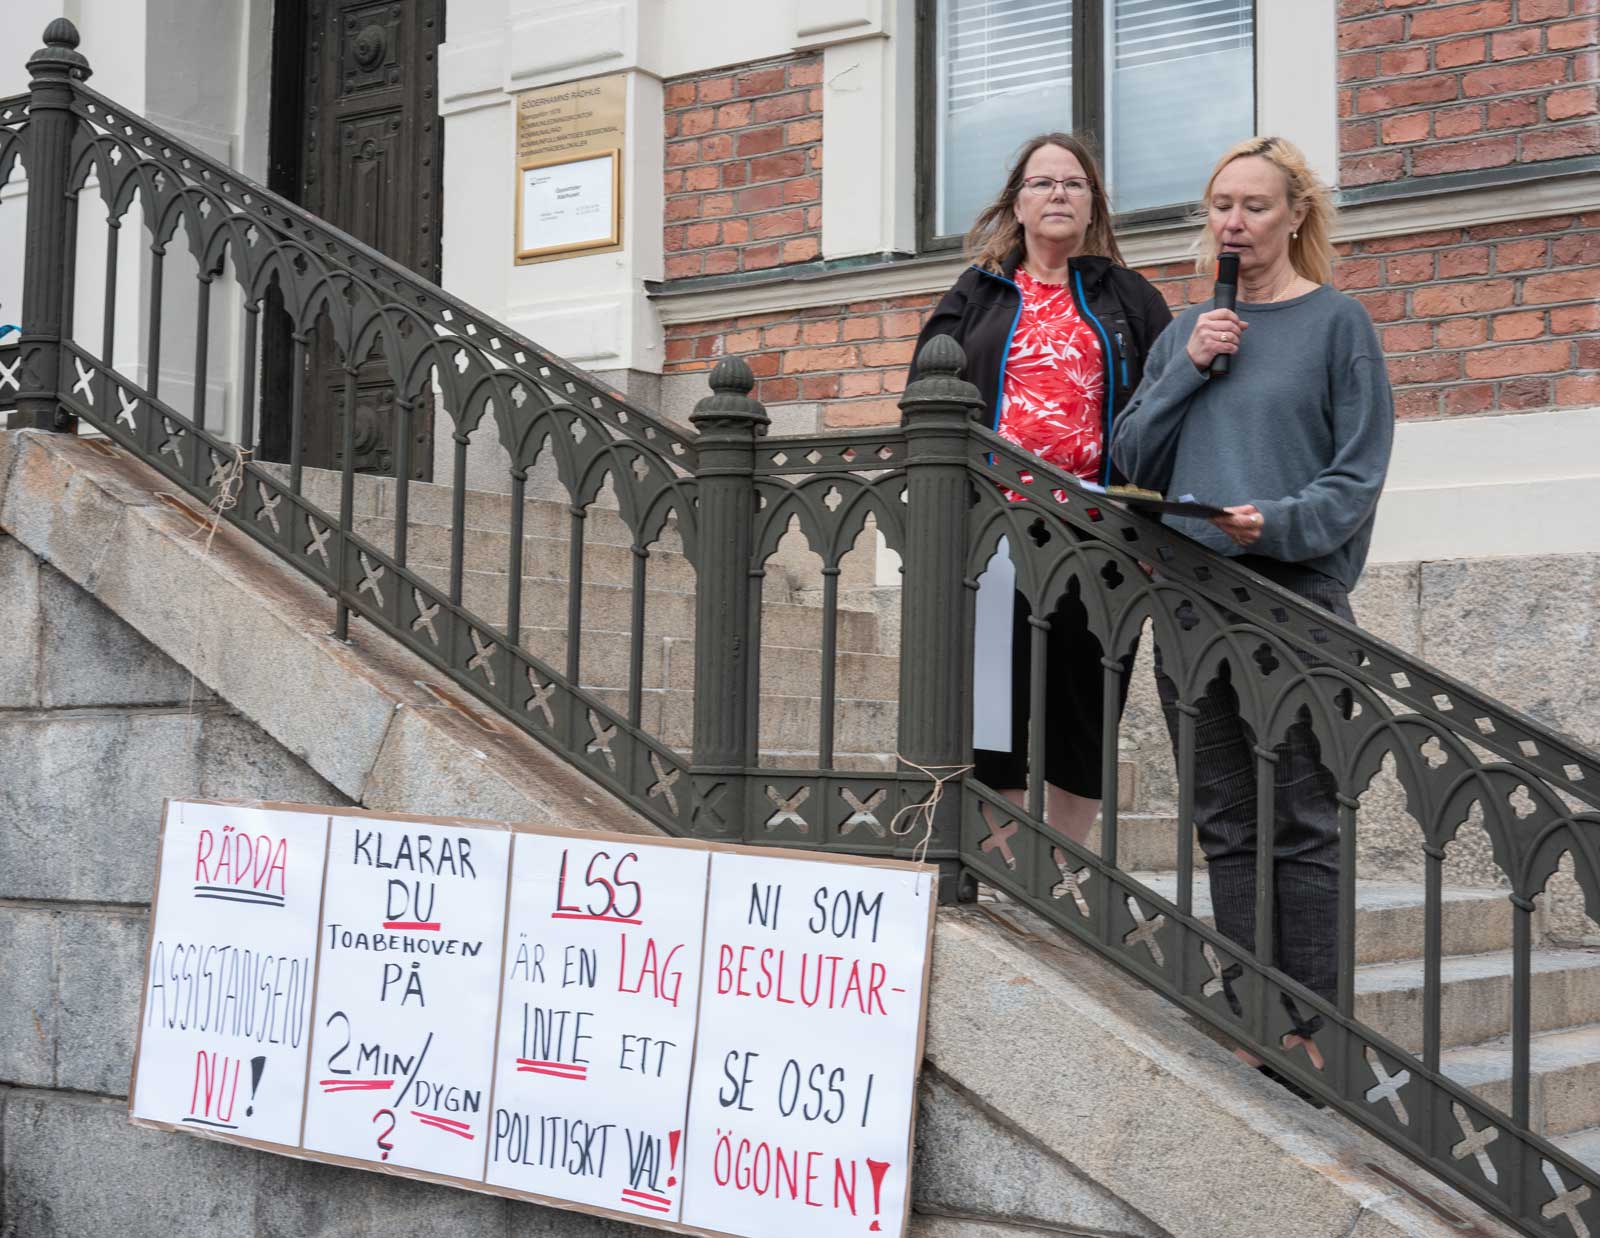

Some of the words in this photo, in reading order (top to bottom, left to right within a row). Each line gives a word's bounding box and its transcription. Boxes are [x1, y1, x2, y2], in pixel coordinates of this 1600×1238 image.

[195, 825, 287, 896] RÄDDA
[353, 829, 476, 879] KLARAR
[553, 849, 643, 918] LSS
[385, 879, 435, 922] DU
[748, 882, 782, 931] NI
[808, 886, 884, 943] SOM
[327, 924, 482, 956] TOABEHOVEN
[510, 933, 545, 984] ÄR
[561, 945, 597, 988] EN
[617, 933, 685, 1007] LAG
[380, 961, 425, 1007] PÅ
[717, 944, 906, 1015] BESLUTAR-
[522, 1002, 594, 1063] INTE
[619, 1034, 677, 1077] ETT
[719, 1050, 760, 1111] SE
[779, 1059, 845, 1124] OSS
[861, 1073, 874, 1127] I
[494, 1109, 616, 1177] POLITISKT
[625, 1130, 681, 1193] VAL!
[714, 1128, 890, 1231] ÖGONEN!
